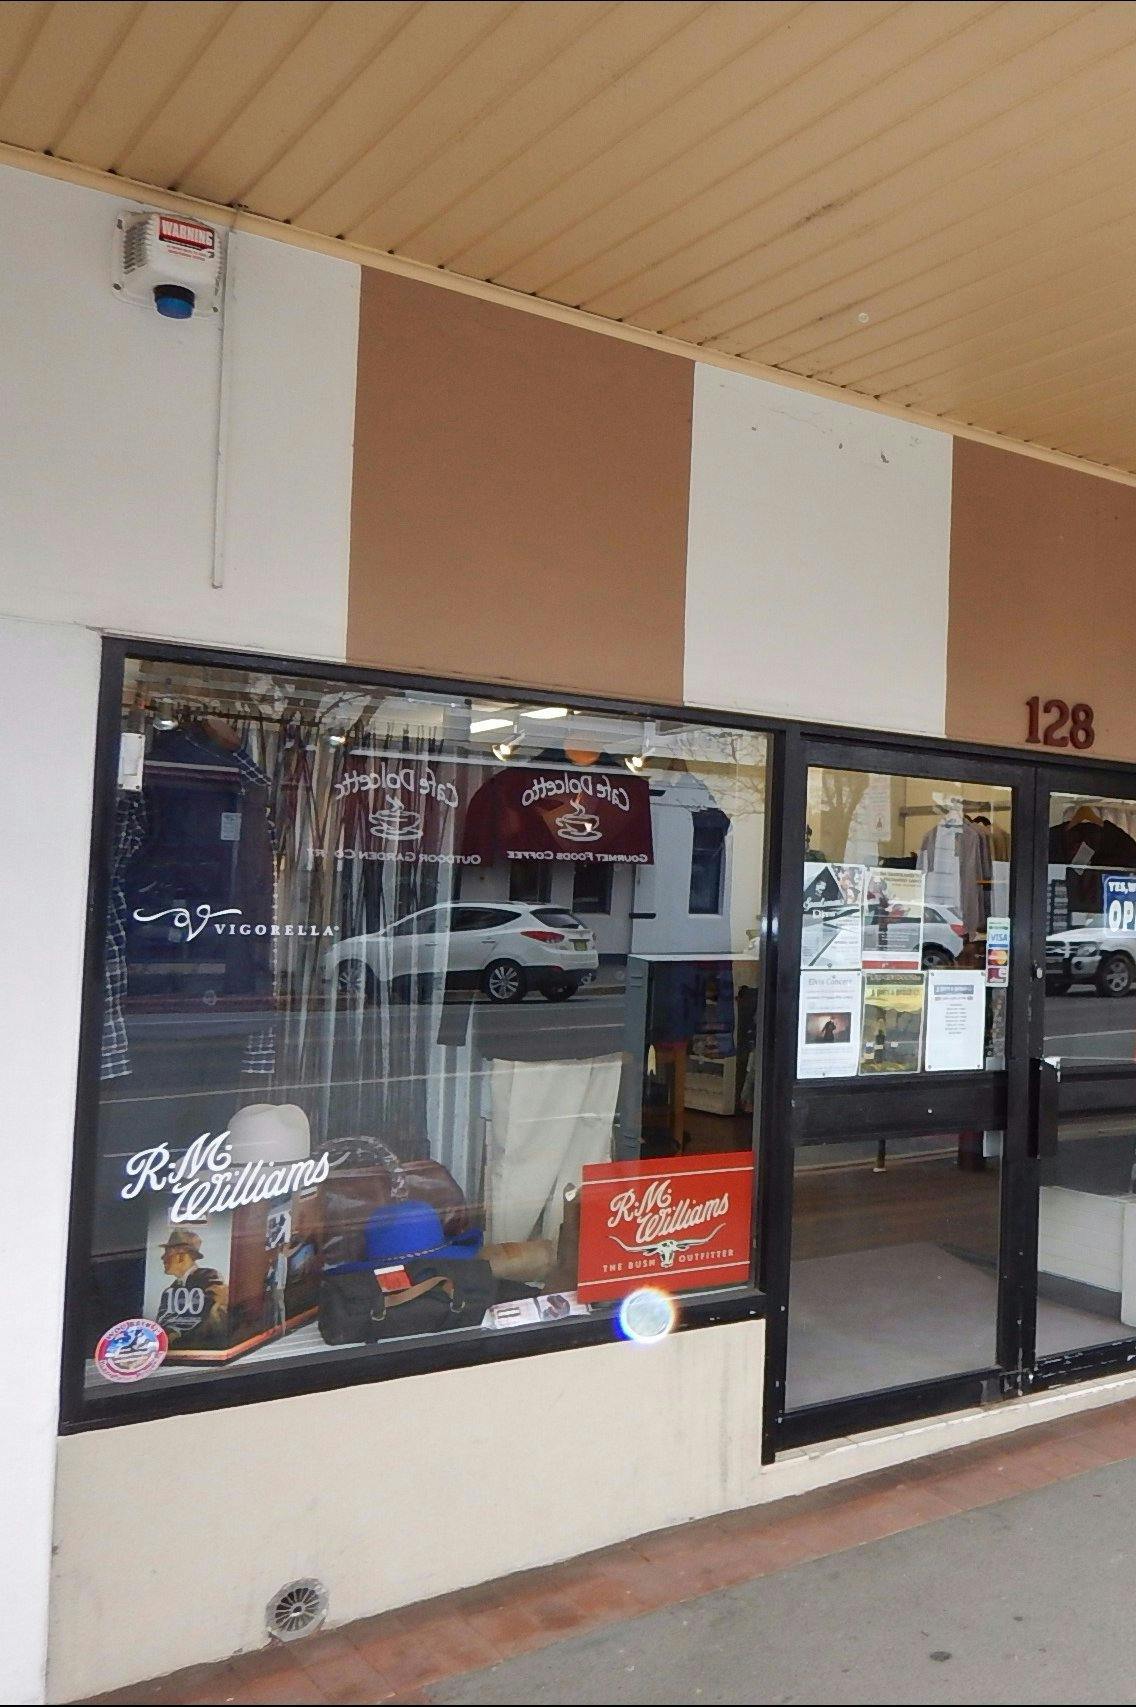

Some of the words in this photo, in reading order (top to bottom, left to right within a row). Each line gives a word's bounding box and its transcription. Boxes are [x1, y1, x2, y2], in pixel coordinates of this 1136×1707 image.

[161, 219, 213, 247] WARNING
[1025, 696, 1095, 750] 128
[213, 923, 334, 937] VIGORELLA
[990, 933, 1008, 942] VISA
[171, 1151, 330, 1223] Williams
[635, 1192, 730, 1244] Williams
[602, 1264, 622, 1273] THE
[627, 1258, 657, 1271] BUSH
[678, 1248, 734, 1263] OUTFITTER
[165, 1287, 205, 1315] 100
